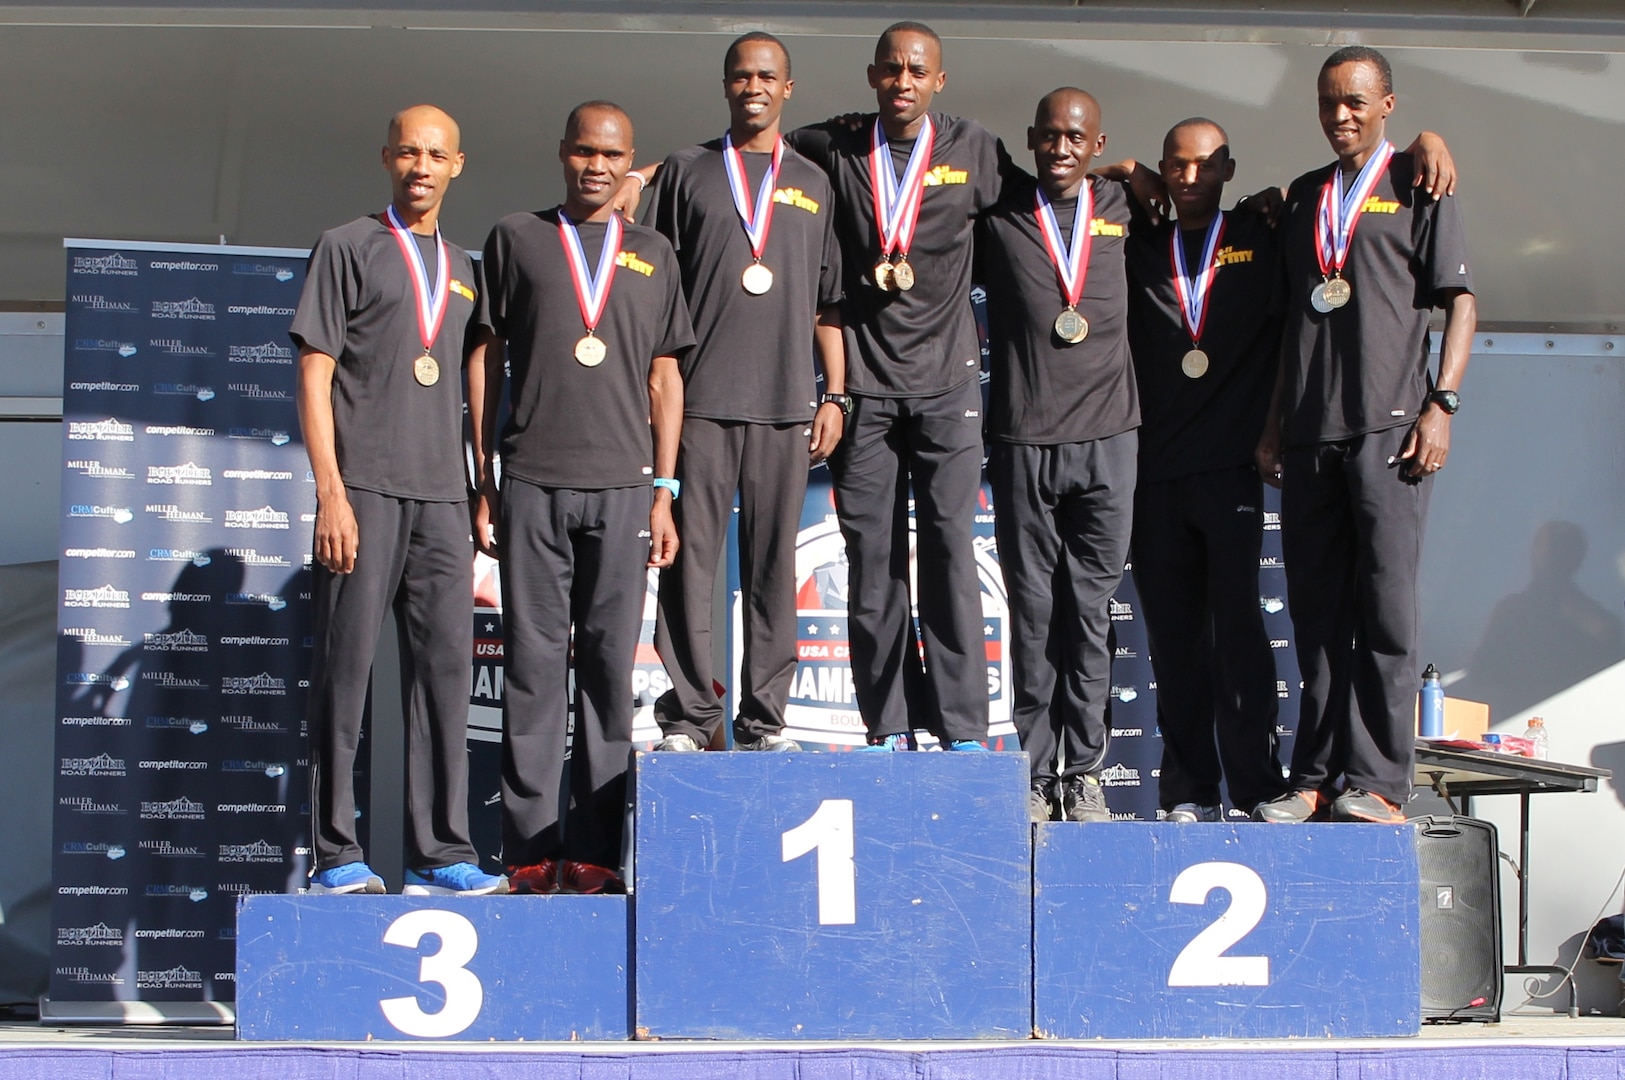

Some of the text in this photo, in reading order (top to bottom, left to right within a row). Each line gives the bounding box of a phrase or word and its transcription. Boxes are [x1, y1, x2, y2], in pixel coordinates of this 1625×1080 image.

[150, 261, 218, 272] competitor.com
[72, 295, 104, 303] MILLER
[93, 301, 130, 310] HEIMAN
[228, 305, 295, 315] competitor.com
[171, 345, 208, 354] HEIMAN
[70, 382, 139, 392] competitor.com
[249, 389, 287, 398] HEIMAN
[146, 426, 215, 436] competitor.com
[88, 467, 126, 475] HEIMAN
[223, 470, 292, 480] competitor.com
[167, 510, 204, 519] HEIMAN
[66, 548, 135, 559] competitor.com
[245, 555, 283, 563] HEIMAN
[142, 592, 211, 602] competitor.com
[85, 634, 122, 643] HEIMAN
[221, 636, 289, 646] competitor.com
[477, 644, 504, 655] USA
[799, 645, 829, 657] USA
[142, 672, 175, 680] MILLER
[163, 678, 201, 686] HEIMAN
[62, 717, 131, 727] competitor.com
[242, 722, 279, 730] HEIMAN
[139, 760, 207, 770] competitor.com
[1105, 778, 1140, 786] RUNNERS
[80, 803, 118, 812] HEIMAN
[217, 803, 286, 813] competitor.com
[160, 847, 197, 855] HEIMAN
[781, 799, 856, 925] 1
[58, 886, 128, 896] competitor.com
[1168, 862, 1269, 987] 2
[135, 929, 204, 939] competitor.com
[77, 973, 114, 982] HEIMAN
[380, 910, 483, 1037] 3
